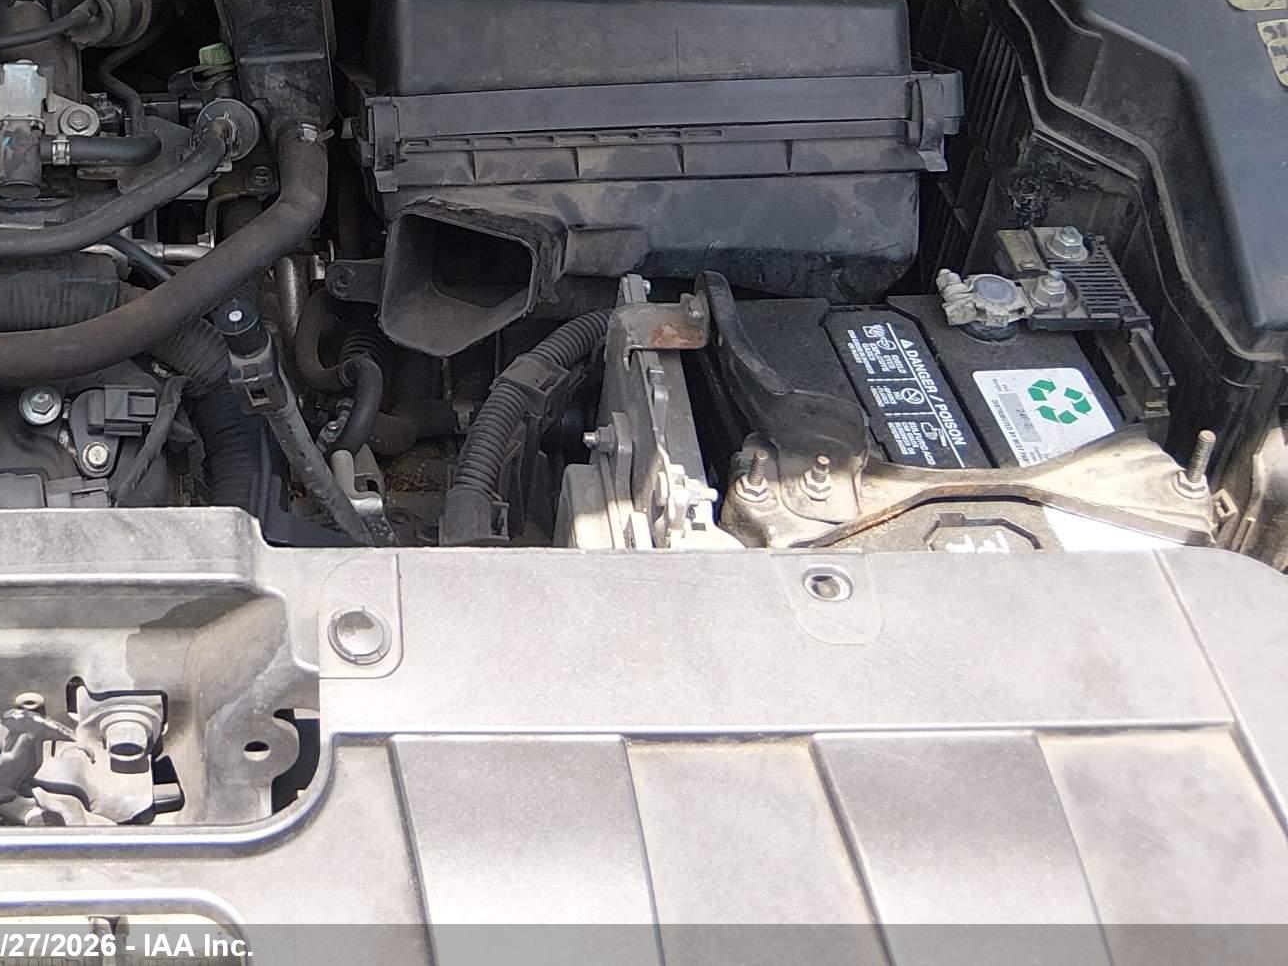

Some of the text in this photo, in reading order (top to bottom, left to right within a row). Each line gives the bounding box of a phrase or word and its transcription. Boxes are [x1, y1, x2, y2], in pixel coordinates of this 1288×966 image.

[905, 350, 938, 392] DANGER
[933, 404, 966, 444] POISON
[921, 451, 936, 464] ACID
